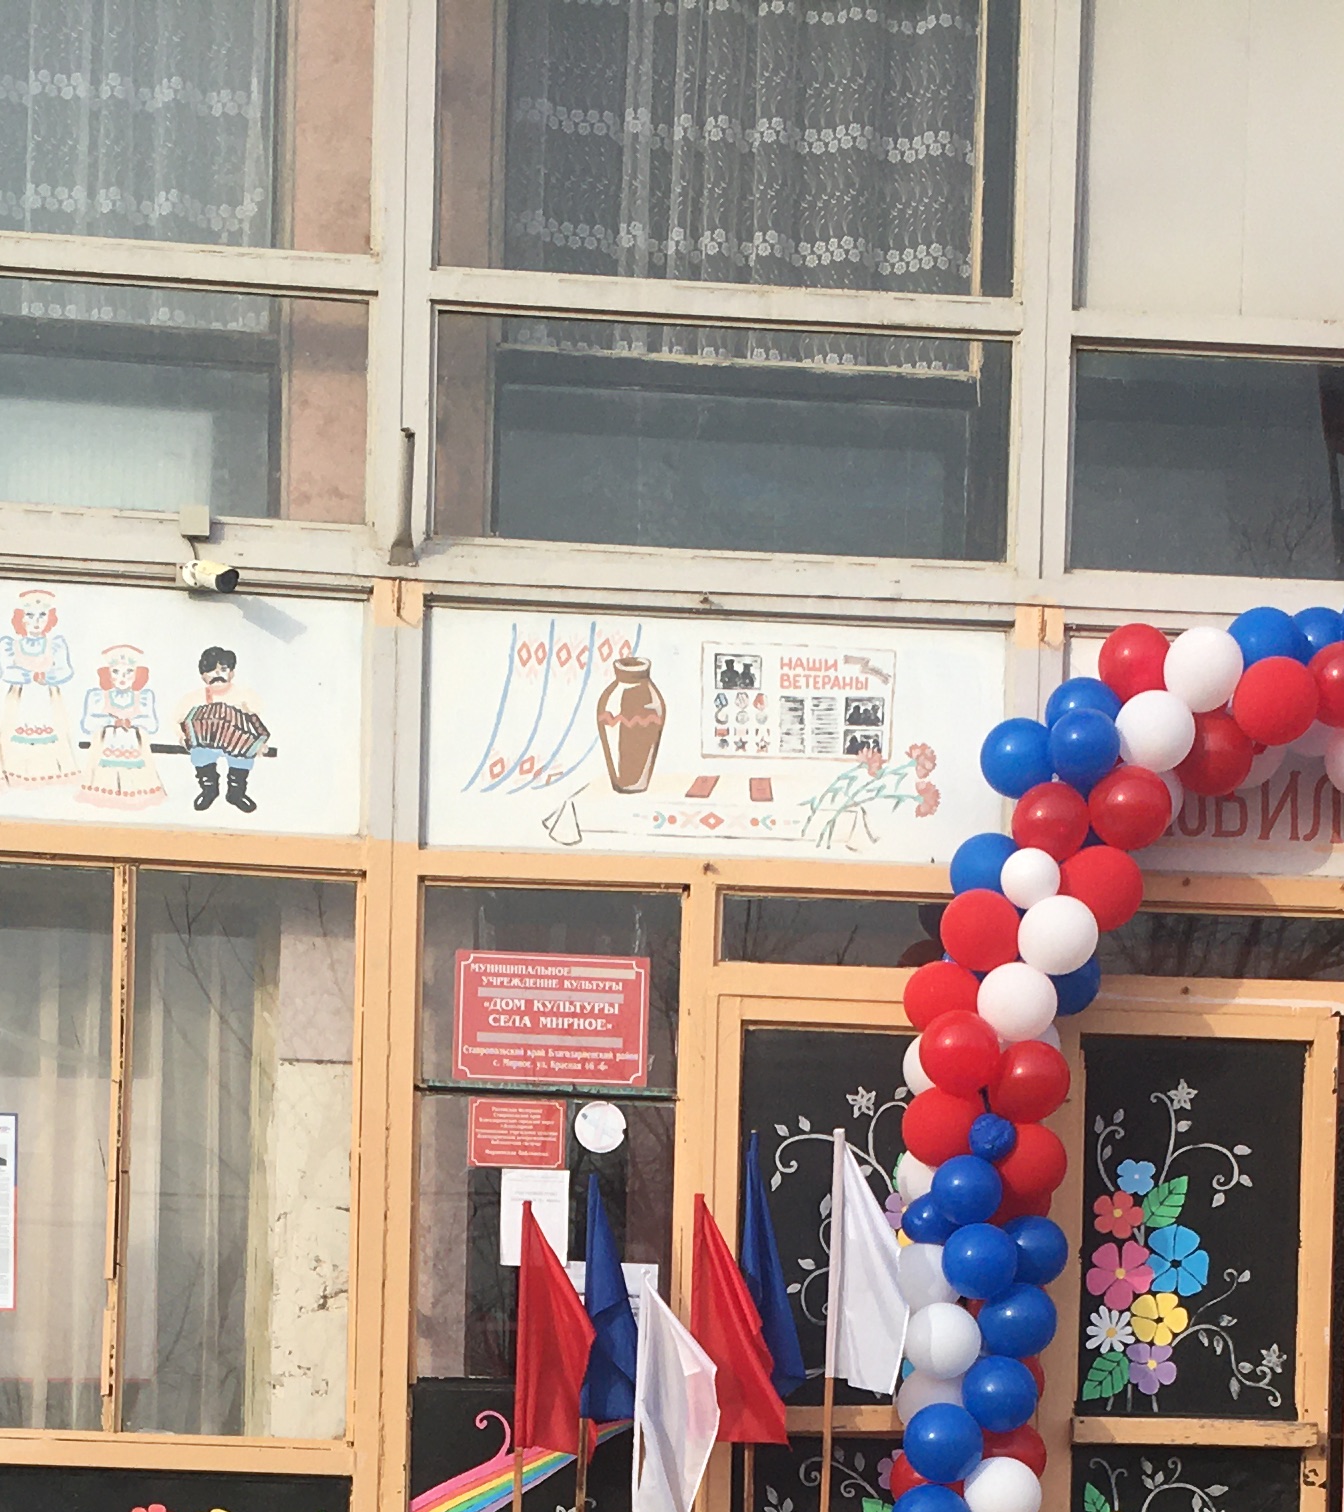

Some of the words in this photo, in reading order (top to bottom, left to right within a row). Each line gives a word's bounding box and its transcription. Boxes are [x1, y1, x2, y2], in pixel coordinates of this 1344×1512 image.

[779, 656, 838, 672] НАШИ
[779, 672, 869, 691] ВЕТЕРАНЫ
[470, 963, 572, 977] МУНИЦИПАЛЬНОЕ
[481, 976, 559, 988] УЧРЕЖДЕНИЕ
[563, 980, 623, 991] КУЛЬТУРЫ
[483, 998, 526, 1012] «ДОМ
[533, 1000, 619, 1014] КУЛЬТУРЫ
[488, 1014, 531, 1028] СЕЛА
[539, 1017, 613, 1031] МИРНОЕ»
